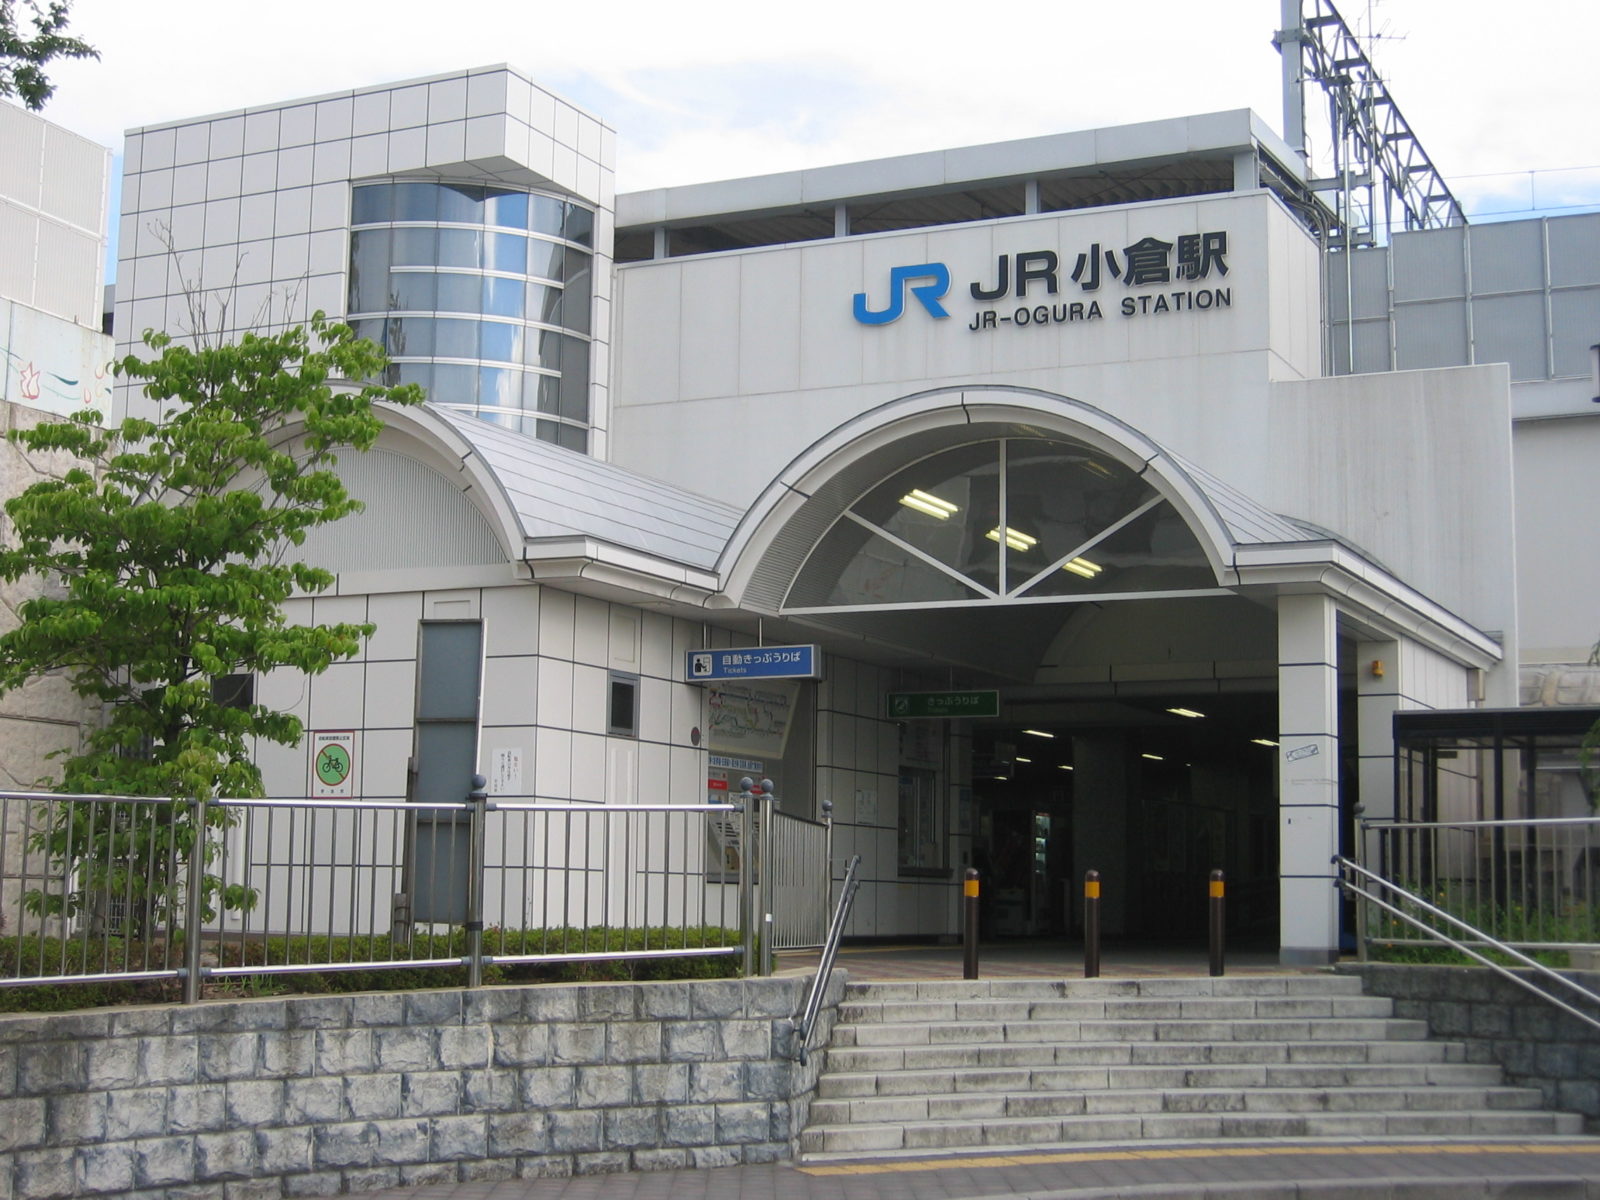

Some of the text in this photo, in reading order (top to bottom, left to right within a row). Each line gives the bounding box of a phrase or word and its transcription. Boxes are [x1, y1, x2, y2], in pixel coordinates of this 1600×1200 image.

[970, 231, 1230, 301] JR小倉駅
[853, 263, 951, 326] JR
[968, 288, 1231, 332] JR-OGURA STATION
[722, 652, 801, 666] 自動きっぷうりば
